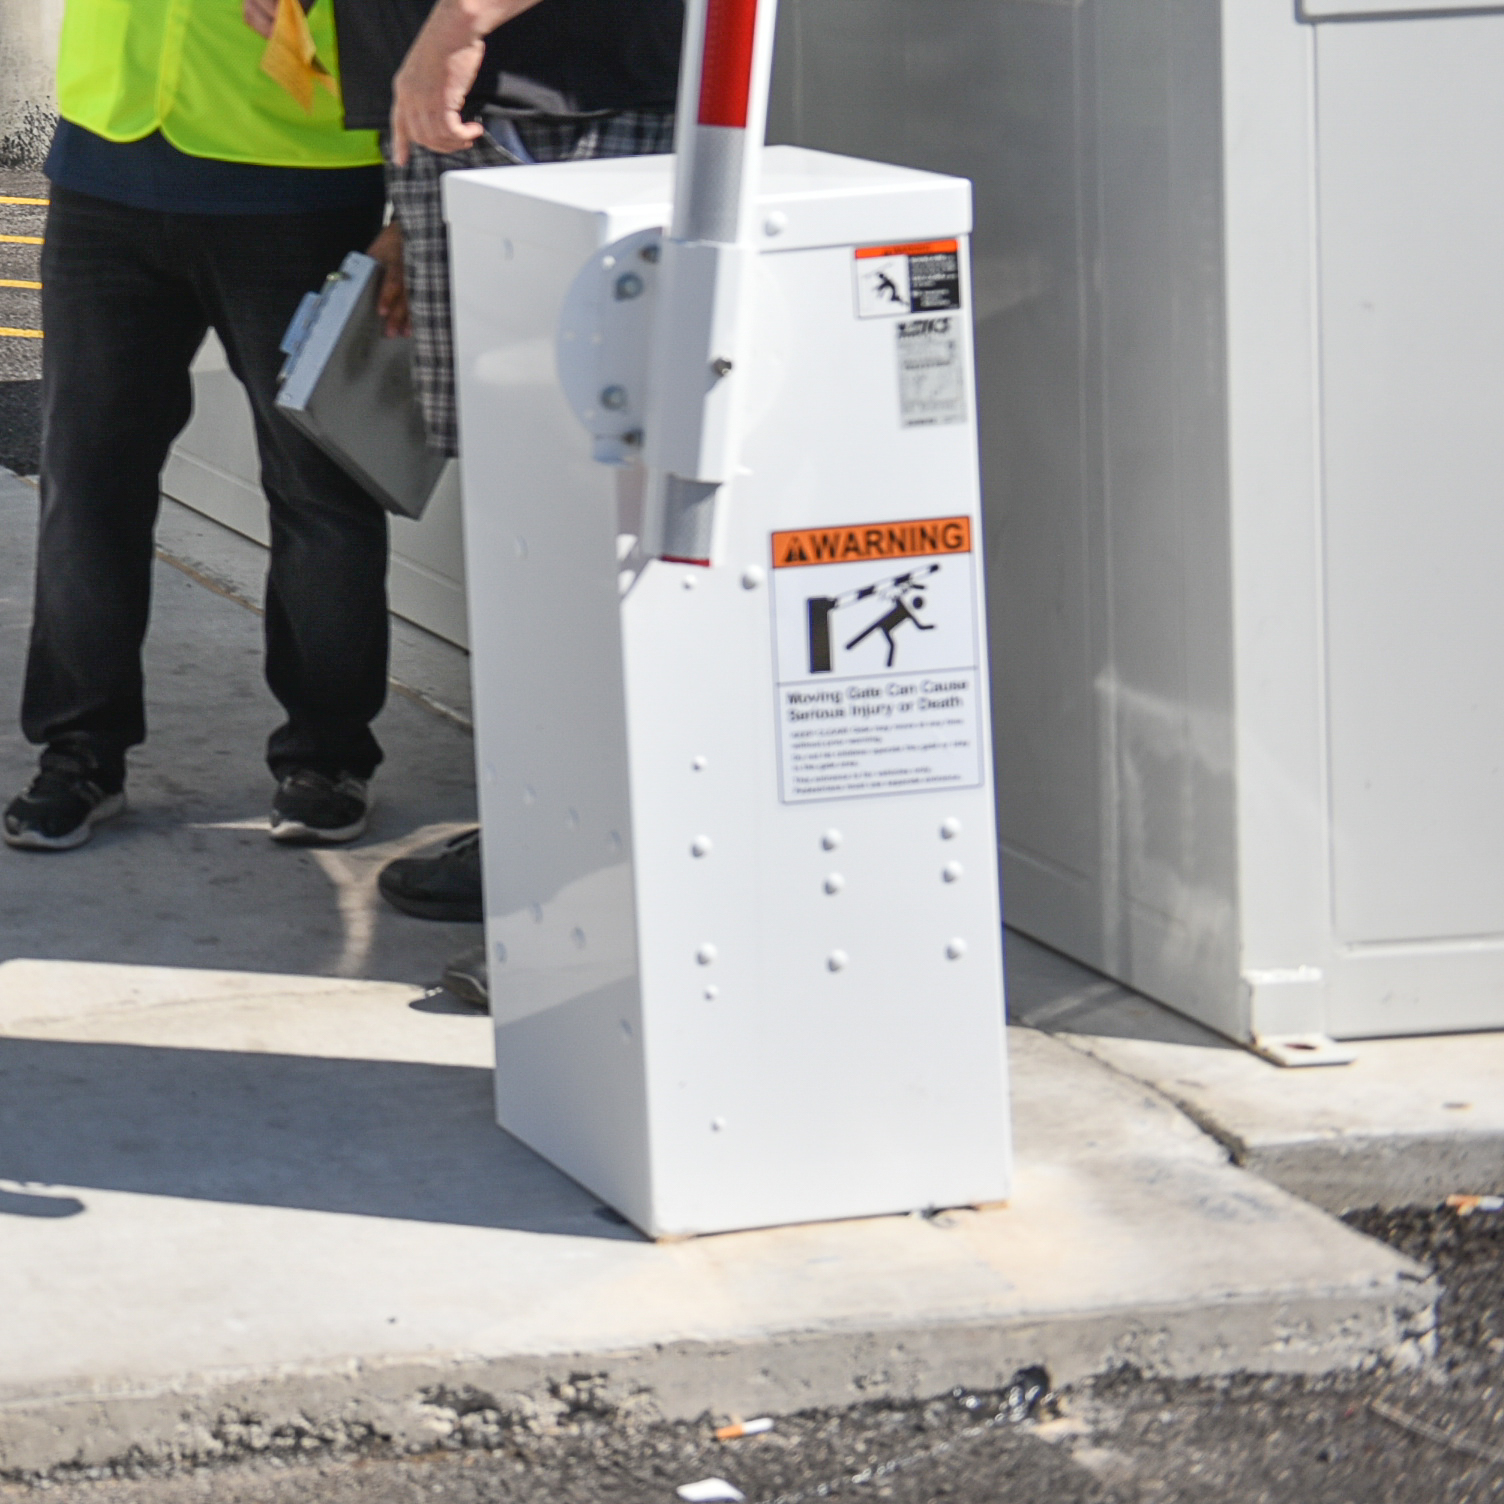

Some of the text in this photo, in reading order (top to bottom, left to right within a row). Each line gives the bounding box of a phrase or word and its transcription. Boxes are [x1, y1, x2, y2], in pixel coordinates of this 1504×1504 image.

[810, 523, 963, 559] WARNING
[788, 679, 967, 705] Moving Gate Can Cause
[789, 696, 960, 721] Serious Injury or Death
